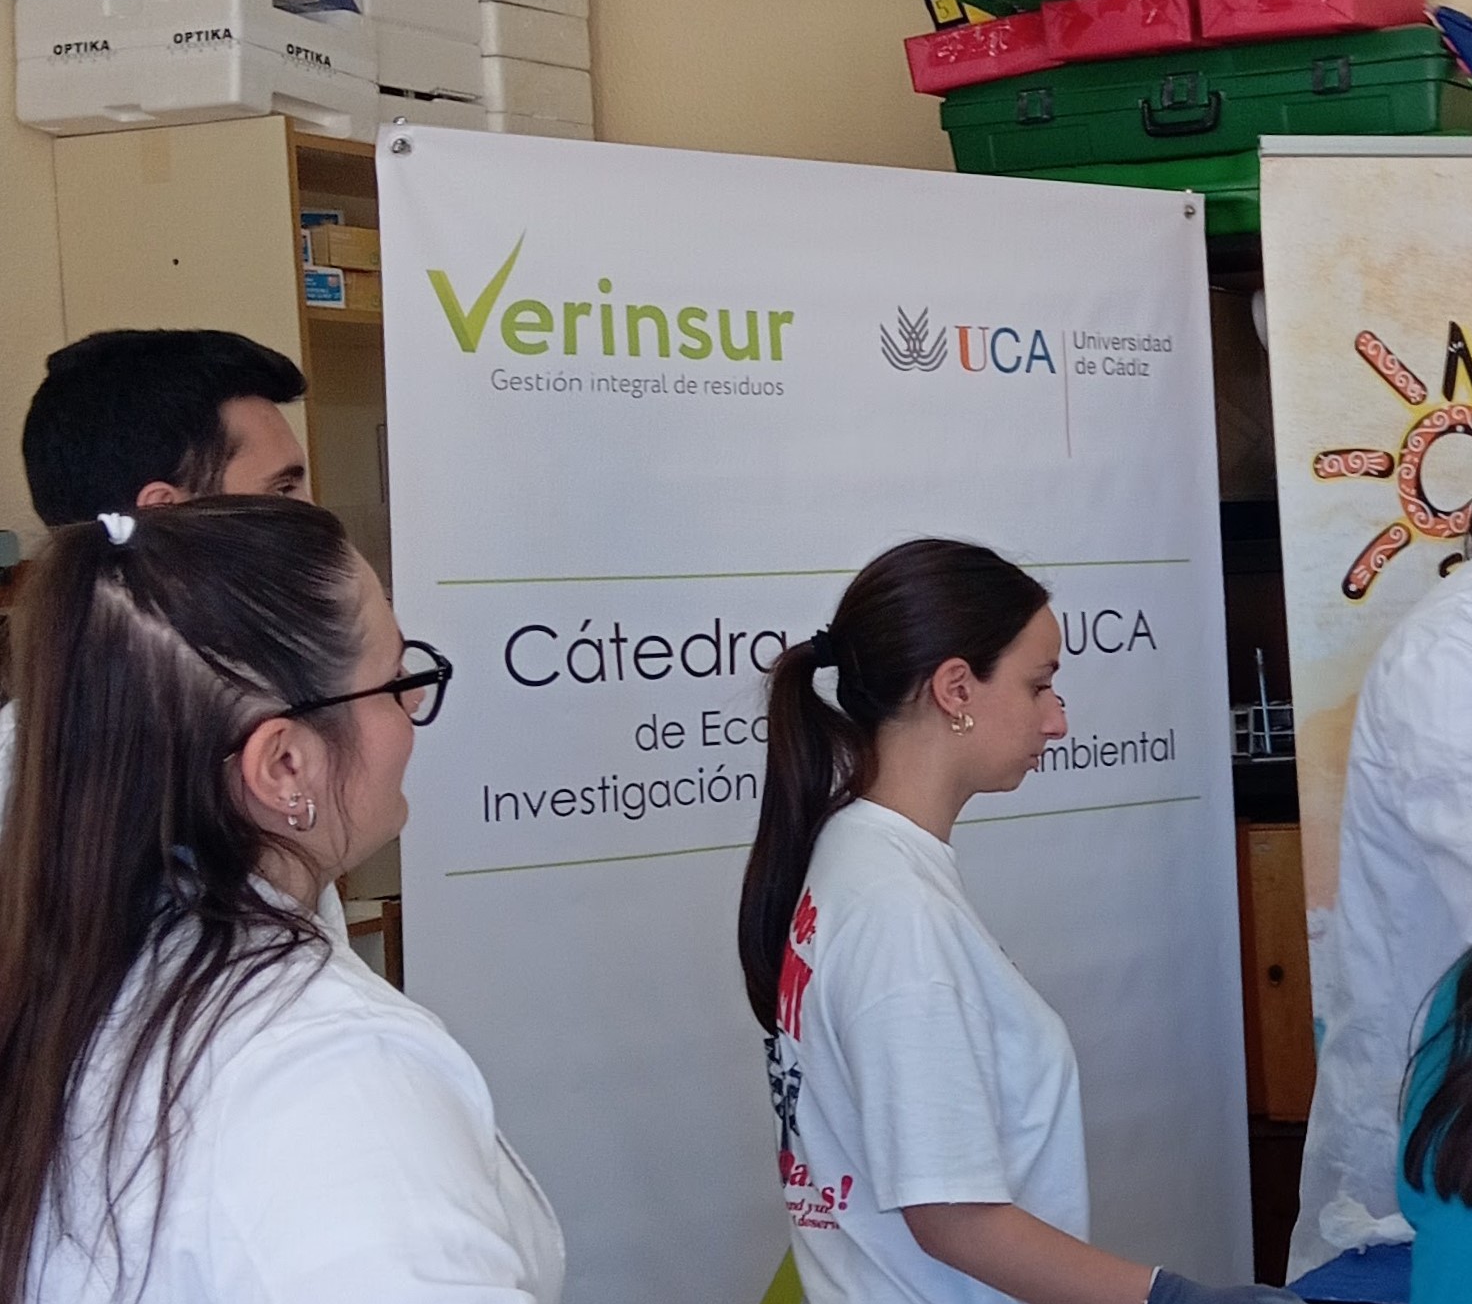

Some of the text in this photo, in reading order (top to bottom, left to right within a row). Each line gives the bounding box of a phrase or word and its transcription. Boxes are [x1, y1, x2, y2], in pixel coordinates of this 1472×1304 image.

[53, 39, 110, 56] OPTIKA
[173, 28, 232, 45] OPTIKA
[286, 43, 331, 67] OPTIKA
[426, 228, 794, 361] Verinsur
[954, 325, 1057, 375] UCA
[1073, 330, 1173, 353] Universidad
[1075, 356, 1150, 377] de Cádiz
[490, 368, 785, 399] Gestión integral de residuos
[504, 617, 789, 687] Cátedra
[635, 713, 686, 751] de
[483, 728, 1175, 823] Investigación mbiental
